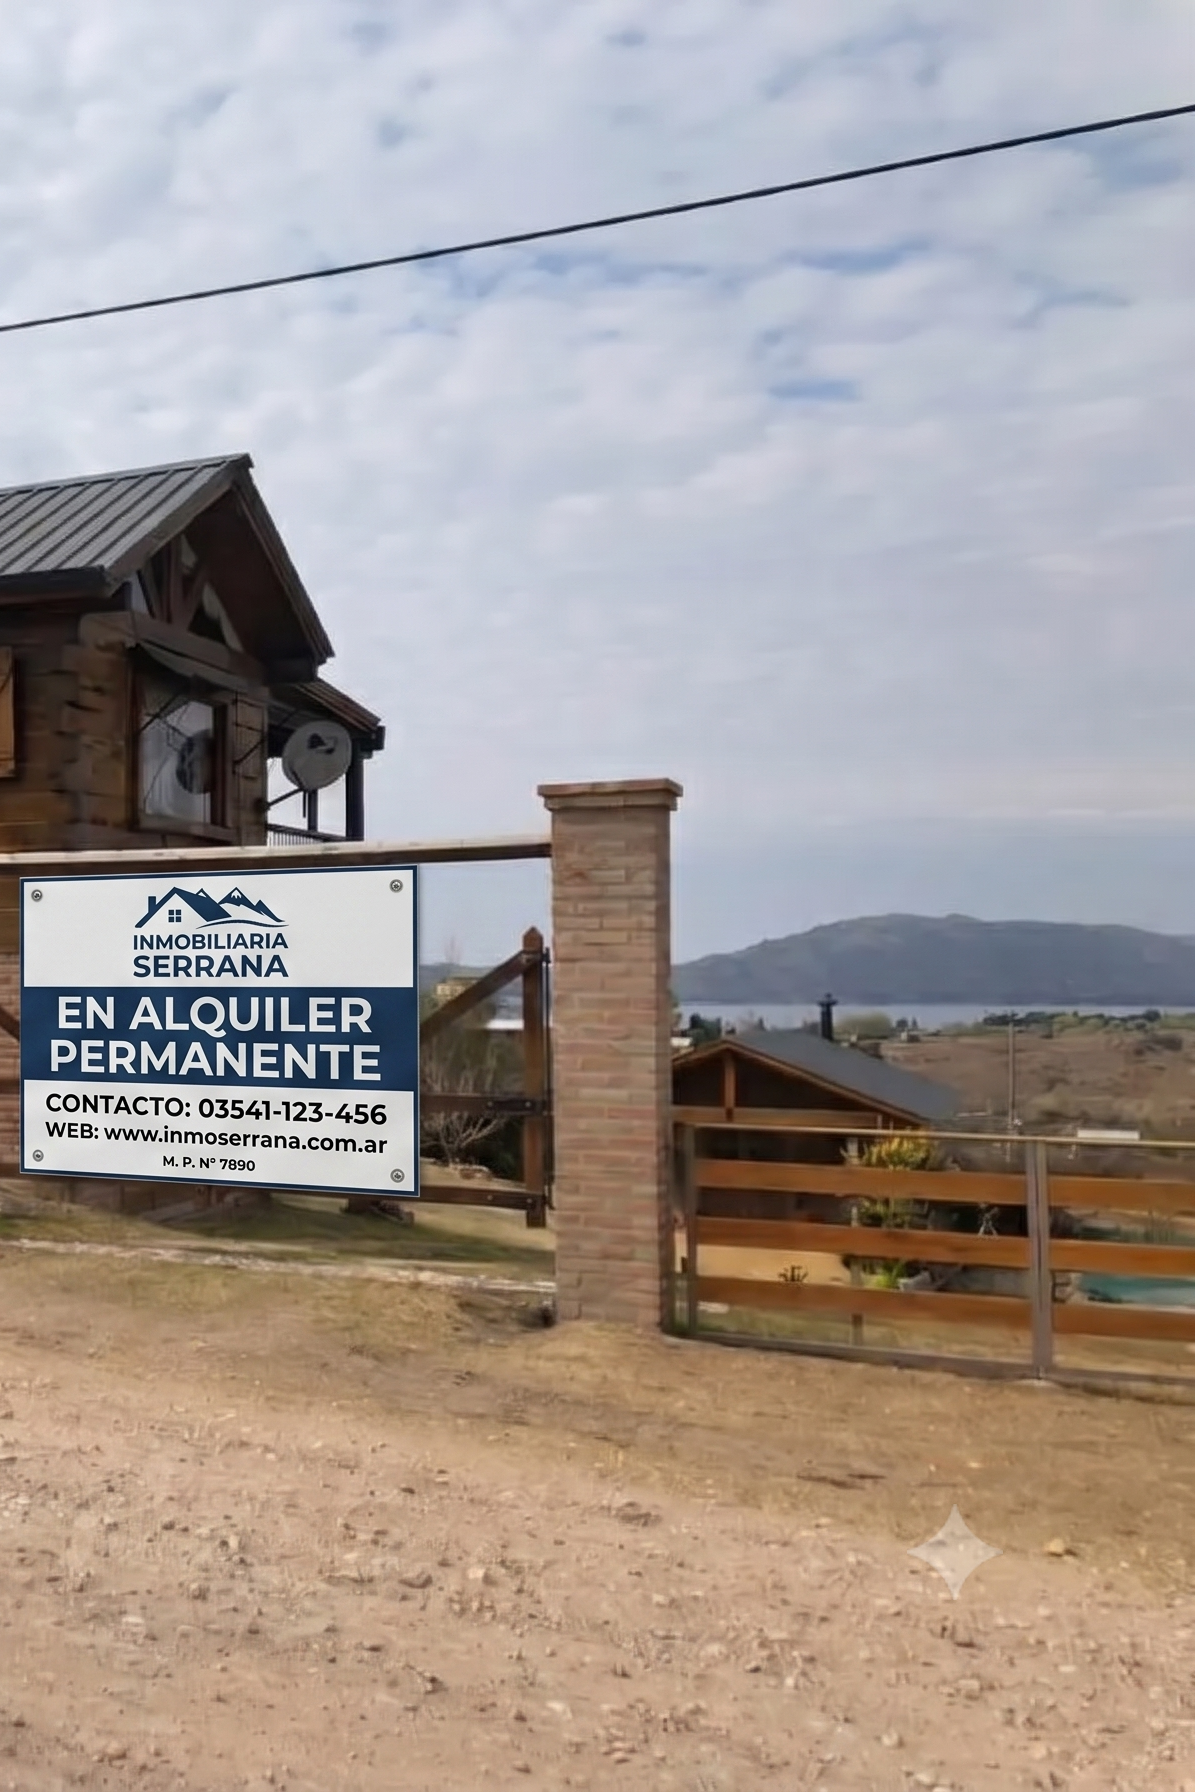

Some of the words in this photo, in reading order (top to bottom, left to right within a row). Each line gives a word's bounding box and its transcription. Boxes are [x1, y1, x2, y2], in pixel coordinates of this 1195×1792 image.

[134, 933, 289, 951] INMOBILIARIA
[134, 955, 289, 978] SERRANA
[58, 997, 115, 1030] EN
[129, 997, 372, 1038] ALQUILER
[50, 1040, 381, 1081] PERMANENTE
[46, 1094, 191, 1118] CONTACTO:
[199, 1099, 388, 1126] 03541-123-456
[45, 1122, 99, 1140] WEB:
[104, 1125, 388, 1154] www.inmoserrana.com.ar
[162, 1156, 179, 1168] M.
[182, 1157, 196, 1169] P.
[220, 1159, 256, 1172] 7890
